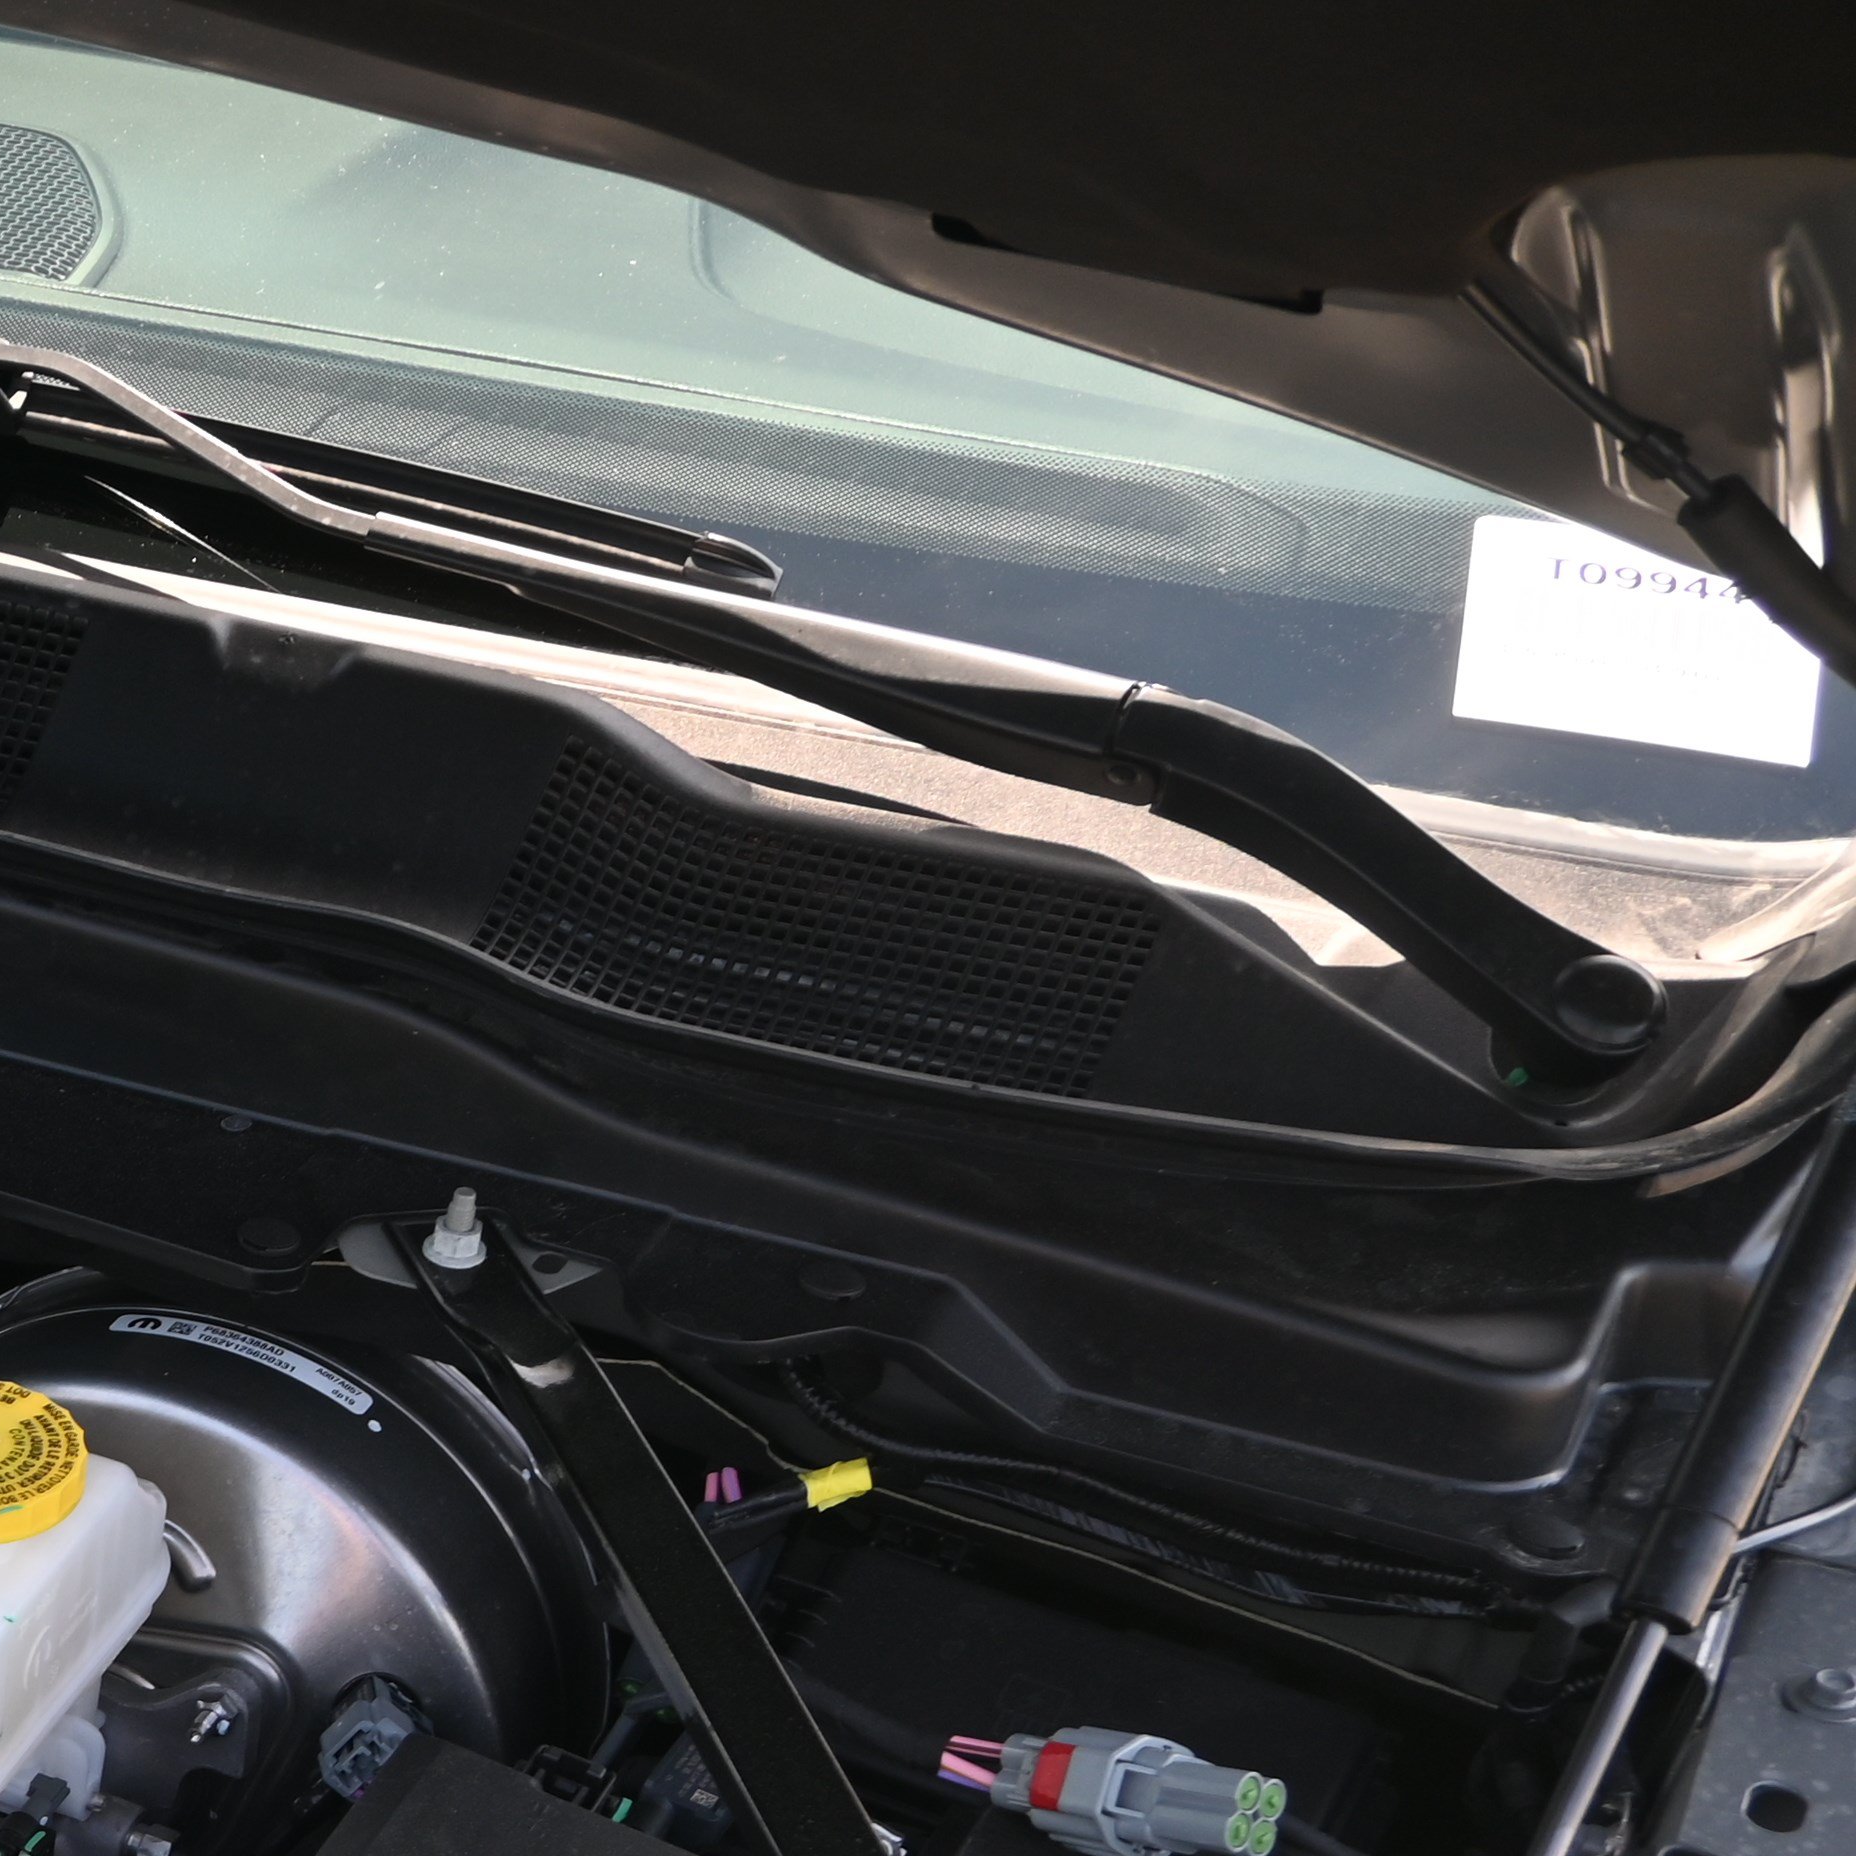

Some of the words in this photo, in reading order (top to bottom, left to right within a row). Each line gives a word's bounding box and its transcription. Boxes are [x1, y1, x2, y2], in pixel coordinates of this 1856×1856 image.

[3, 1384, 32, 1398] DOT
[43, 1403, 66, 1421] MISE
[34, 1414, 55, 1436] AVANT
[64, 1431, 80, 1458] GARDE
[33, 1460, 73, 1496] NETTOYER
